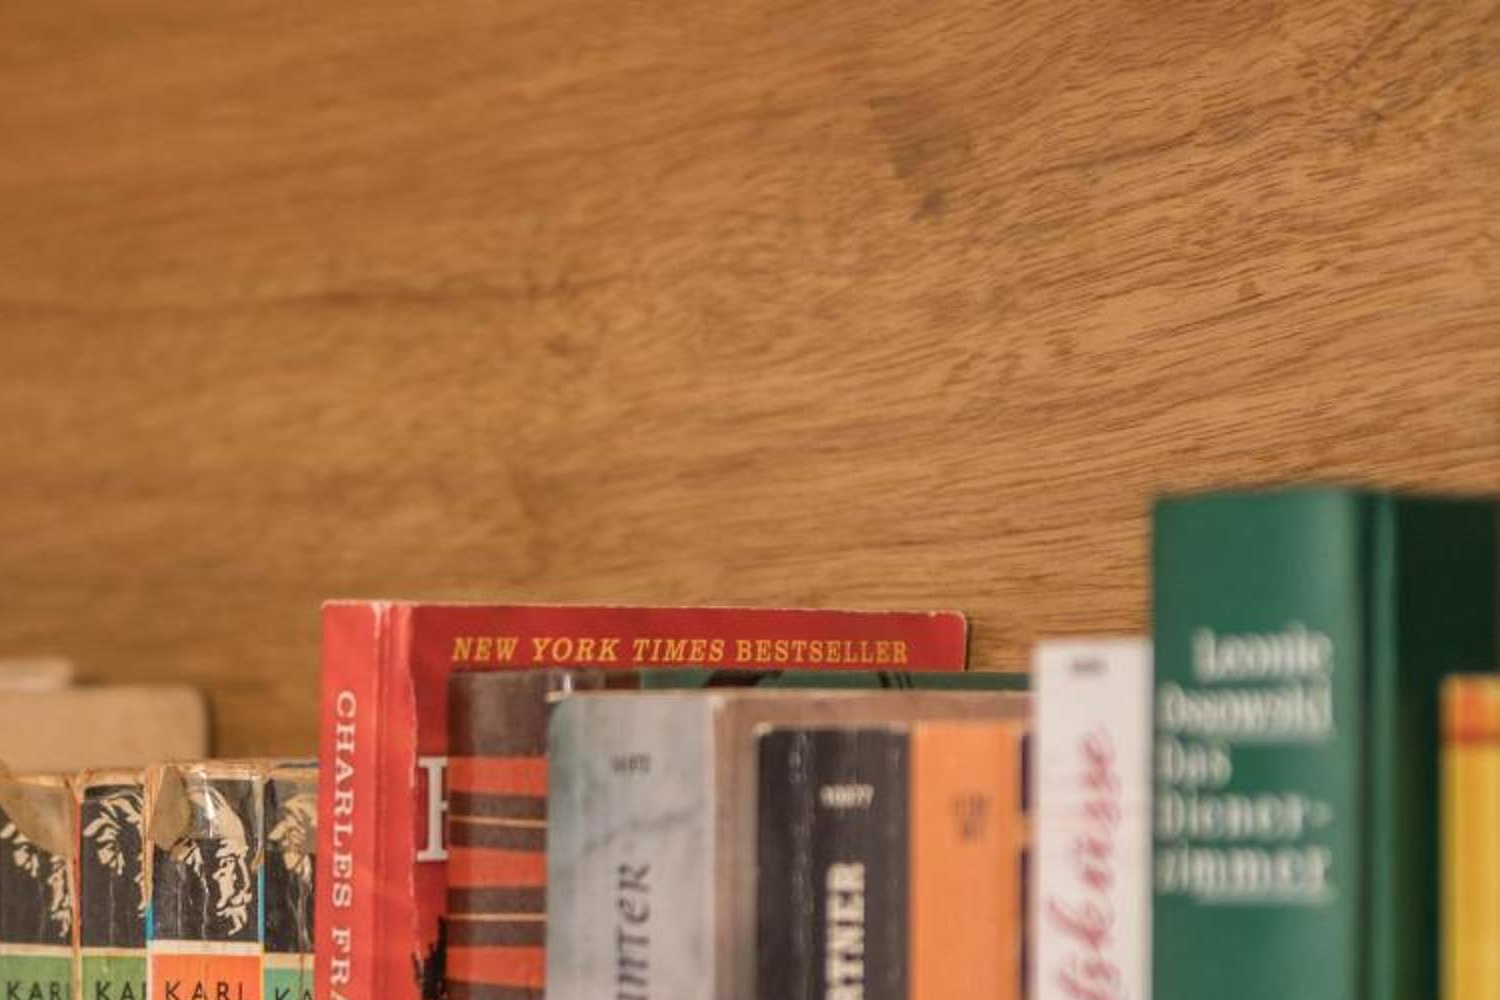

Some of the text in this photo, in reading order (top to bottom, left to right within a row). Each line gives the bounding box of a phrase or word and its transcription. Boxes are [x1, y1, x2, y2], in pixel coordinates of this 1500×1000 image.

[451, 637, 909, 665] NEW YORK TIMES BESTSELLER
[331, 690, 357, 908] CHARLES
